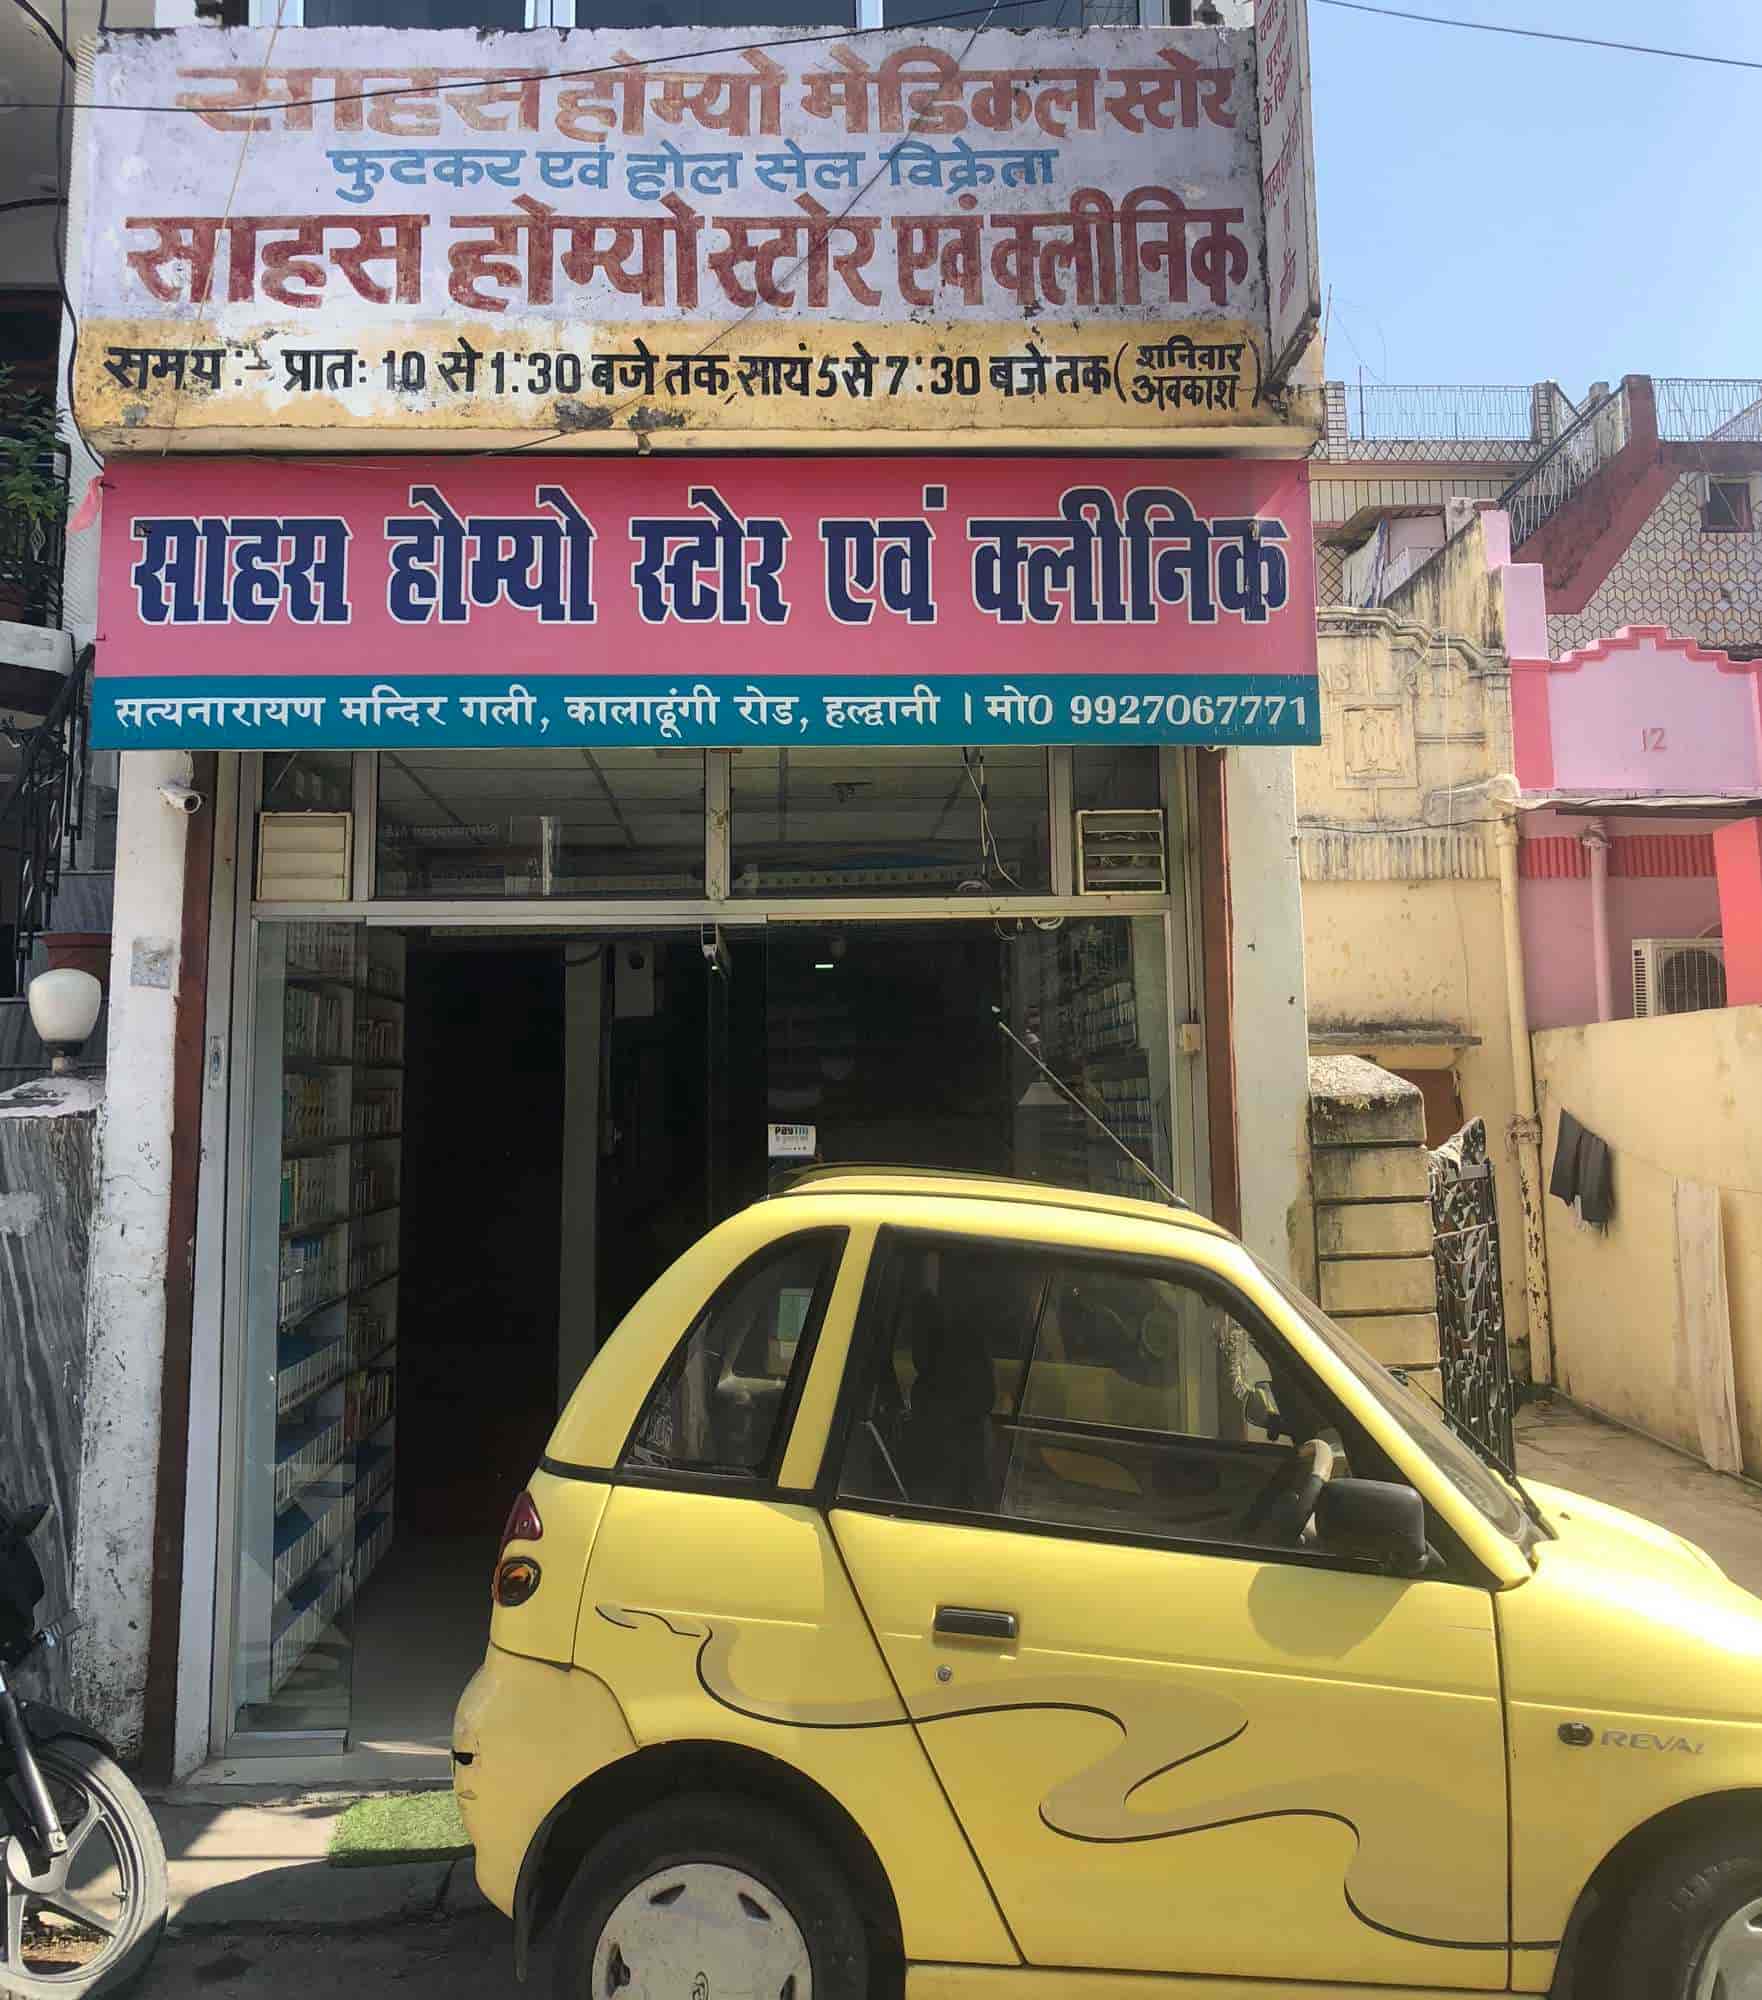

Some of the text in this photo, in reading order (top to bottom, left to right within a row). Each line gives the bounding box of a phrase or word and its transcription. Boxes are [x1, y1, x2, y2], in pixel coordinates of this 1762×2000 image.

[175, 67, 549, 136] साहस
[555, 48, 788, 143] होम्यो
[1104, 48, 1237, 133] स्टोर
[326, 136, 1060, 204] फुटकर एवं होल सेल विक्रेता
[125, 214, 431, 309] साहस
[447, 190, 705, 313] होम्यो
[707, 191, 882, 309] स्टोर
[891, 192, 985, 306] एवं
[989, 185, 1250, 306] क्लीनिक
[103, 346, 227, 390] समय
[382, 350, 427, 391] 10
[436, 336, 483, 393] से
[591, 336, 660, 396] बजे
[737, 341, 814, 397] सायं
[816, 354, 839, 398] 5
[842, 340, 880, 398] से
[886, 355, 981, 397] 7:30
[988, 342, 1052, 397] बजे
[1055, 355, 1112, 395] तक
[130, 483, 1291, 626] साहस होम्यो स्टोर एवं क्लीनिक
[114, 696, 325, 729] सत्यनारायण
[339, 684, 448, 729] मन्दिर
[459, 684, 551, 735] गली,
[564, 684, 721, 738] कालाढूंगी
[733, 684, 809, 735] रोड,
[822, 683, 941, 729] हल्द्वानी
[1069, 694, 1306, 727] 9927067771
